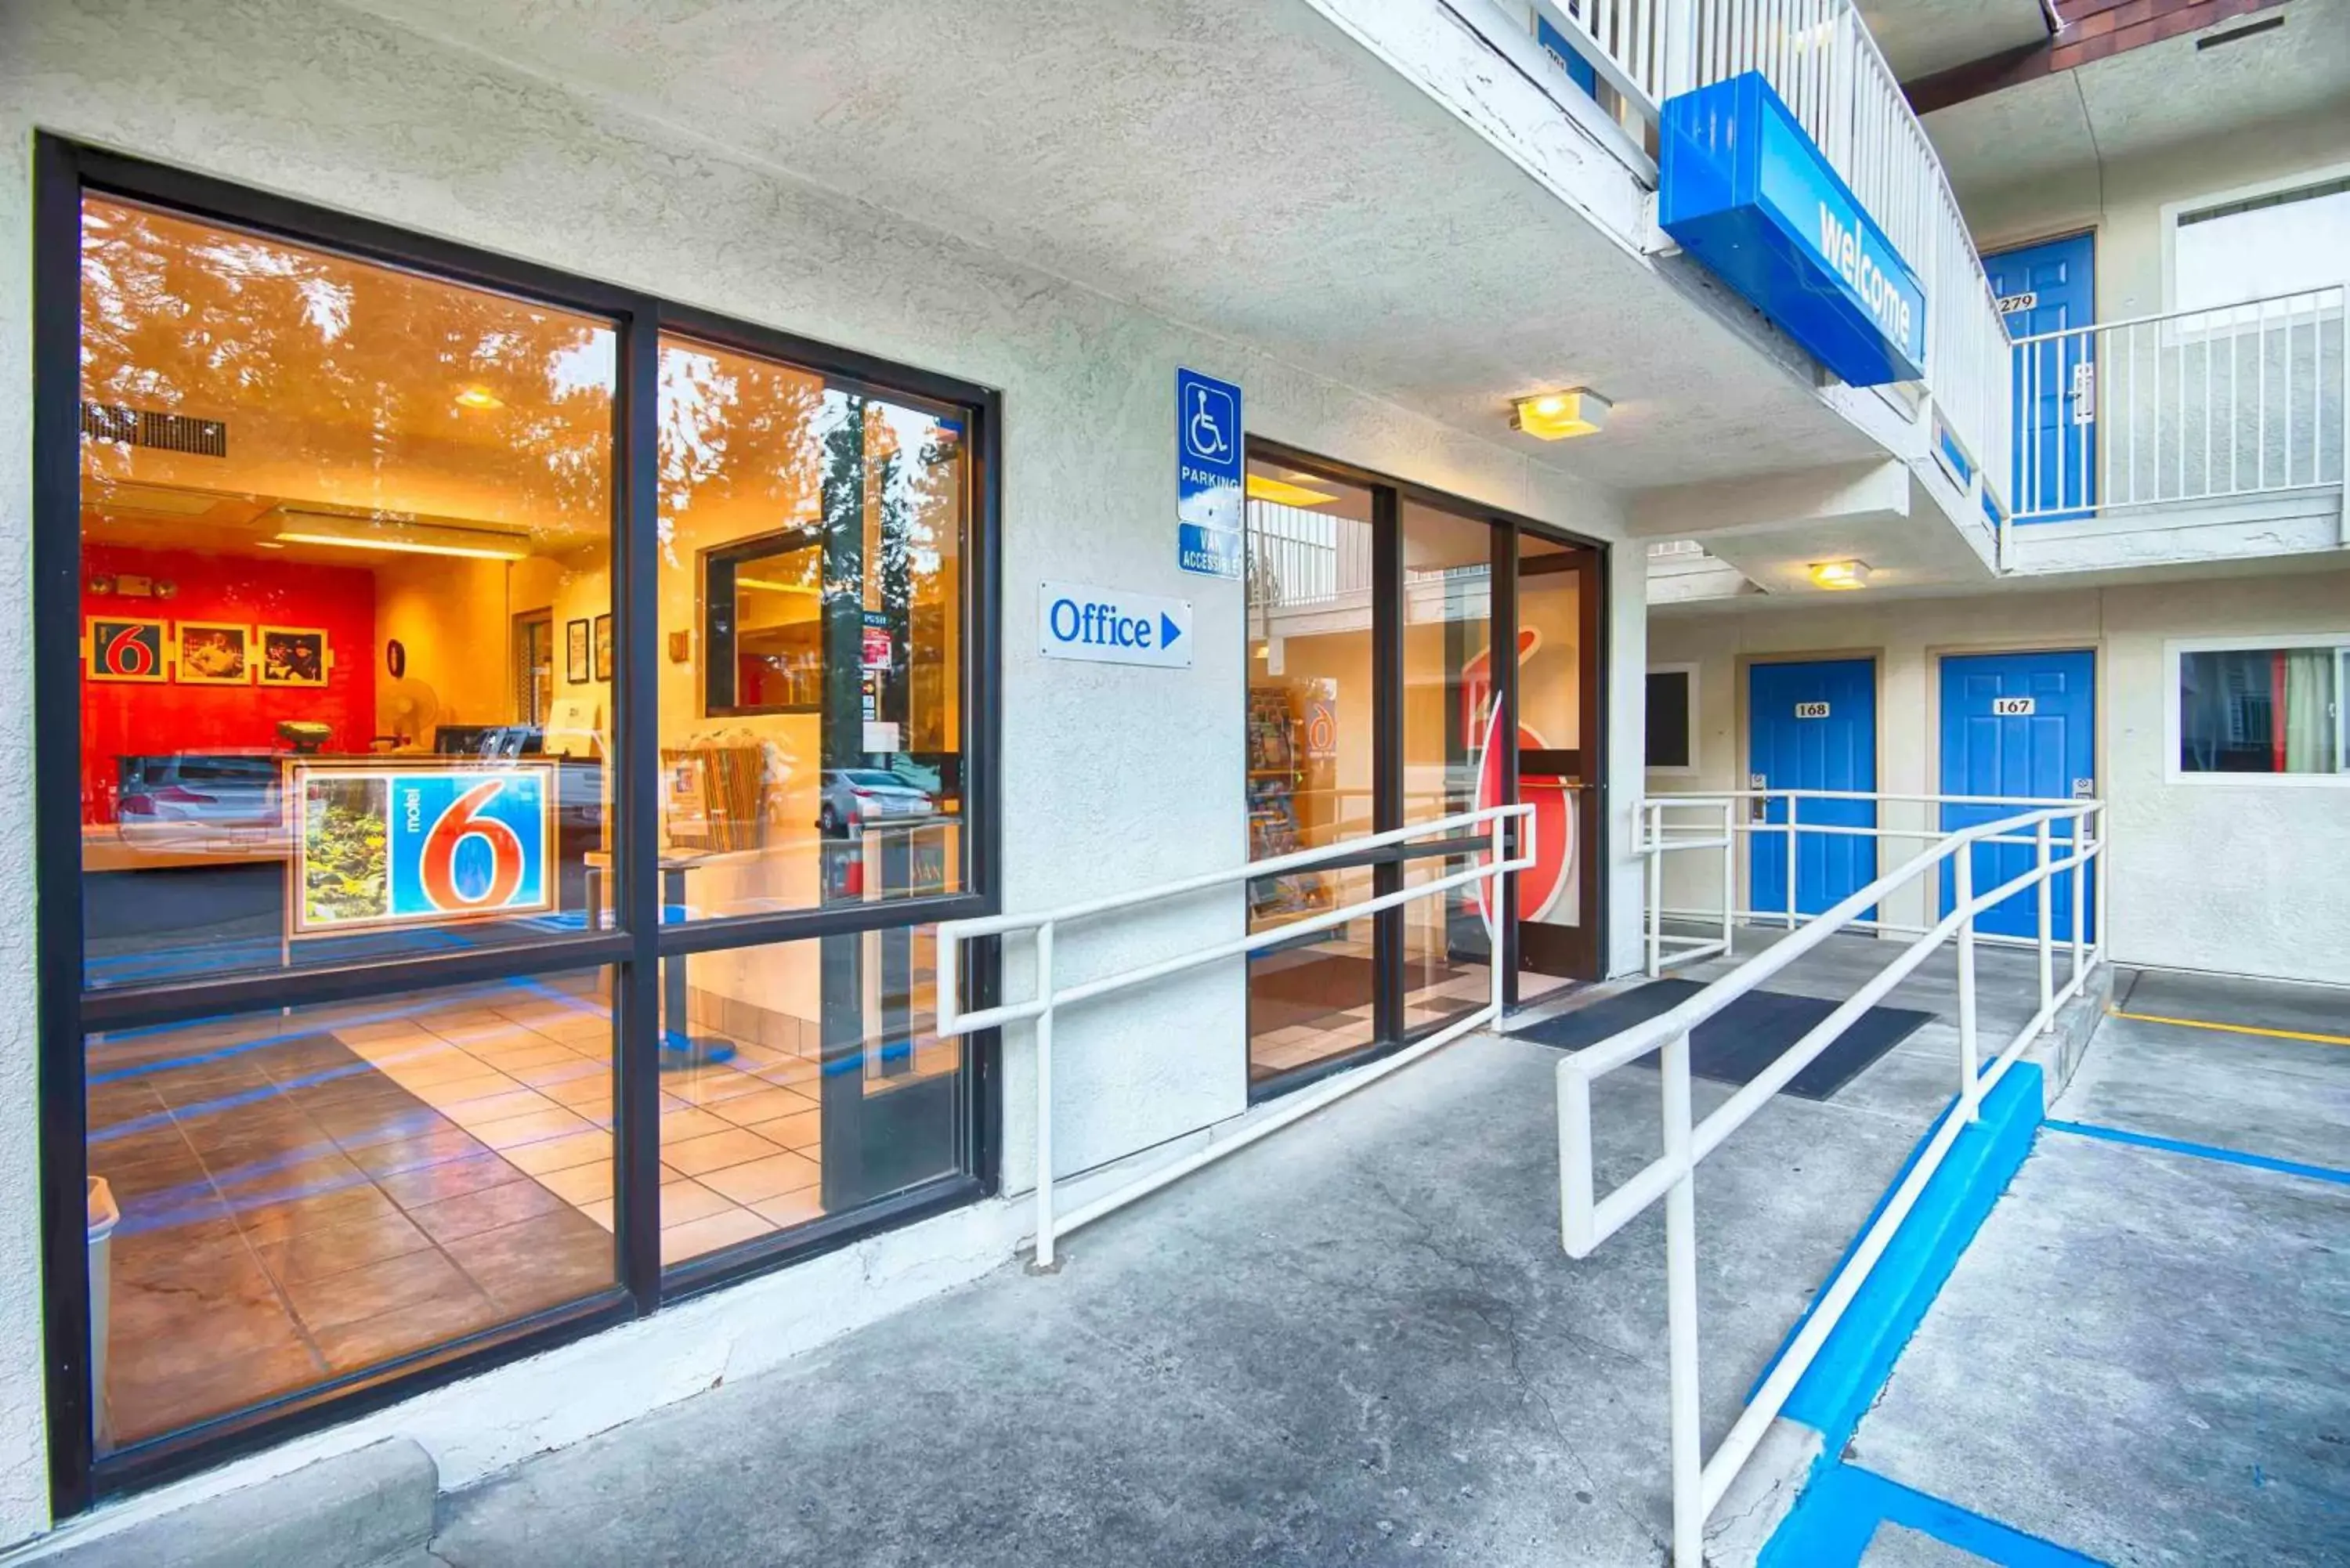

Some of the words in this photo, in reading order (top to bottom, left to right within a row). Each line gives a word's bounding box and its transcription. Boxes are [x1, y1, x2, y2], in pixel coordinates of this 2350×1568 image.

[1820, 201, 1911, 345] welcome
[2000, 294, 2032, 313] 279
[1181, 466, 1238, 491] PARKING
[1050, 598, 1152, 648] Office
[106, 624, 154, 675] 6
[1799, 703, 1826, 716] 168
[1998, 700, 2030, 713] 167
[403, 788, 421, 833] motel
[419, 779, 526, 912] 6
